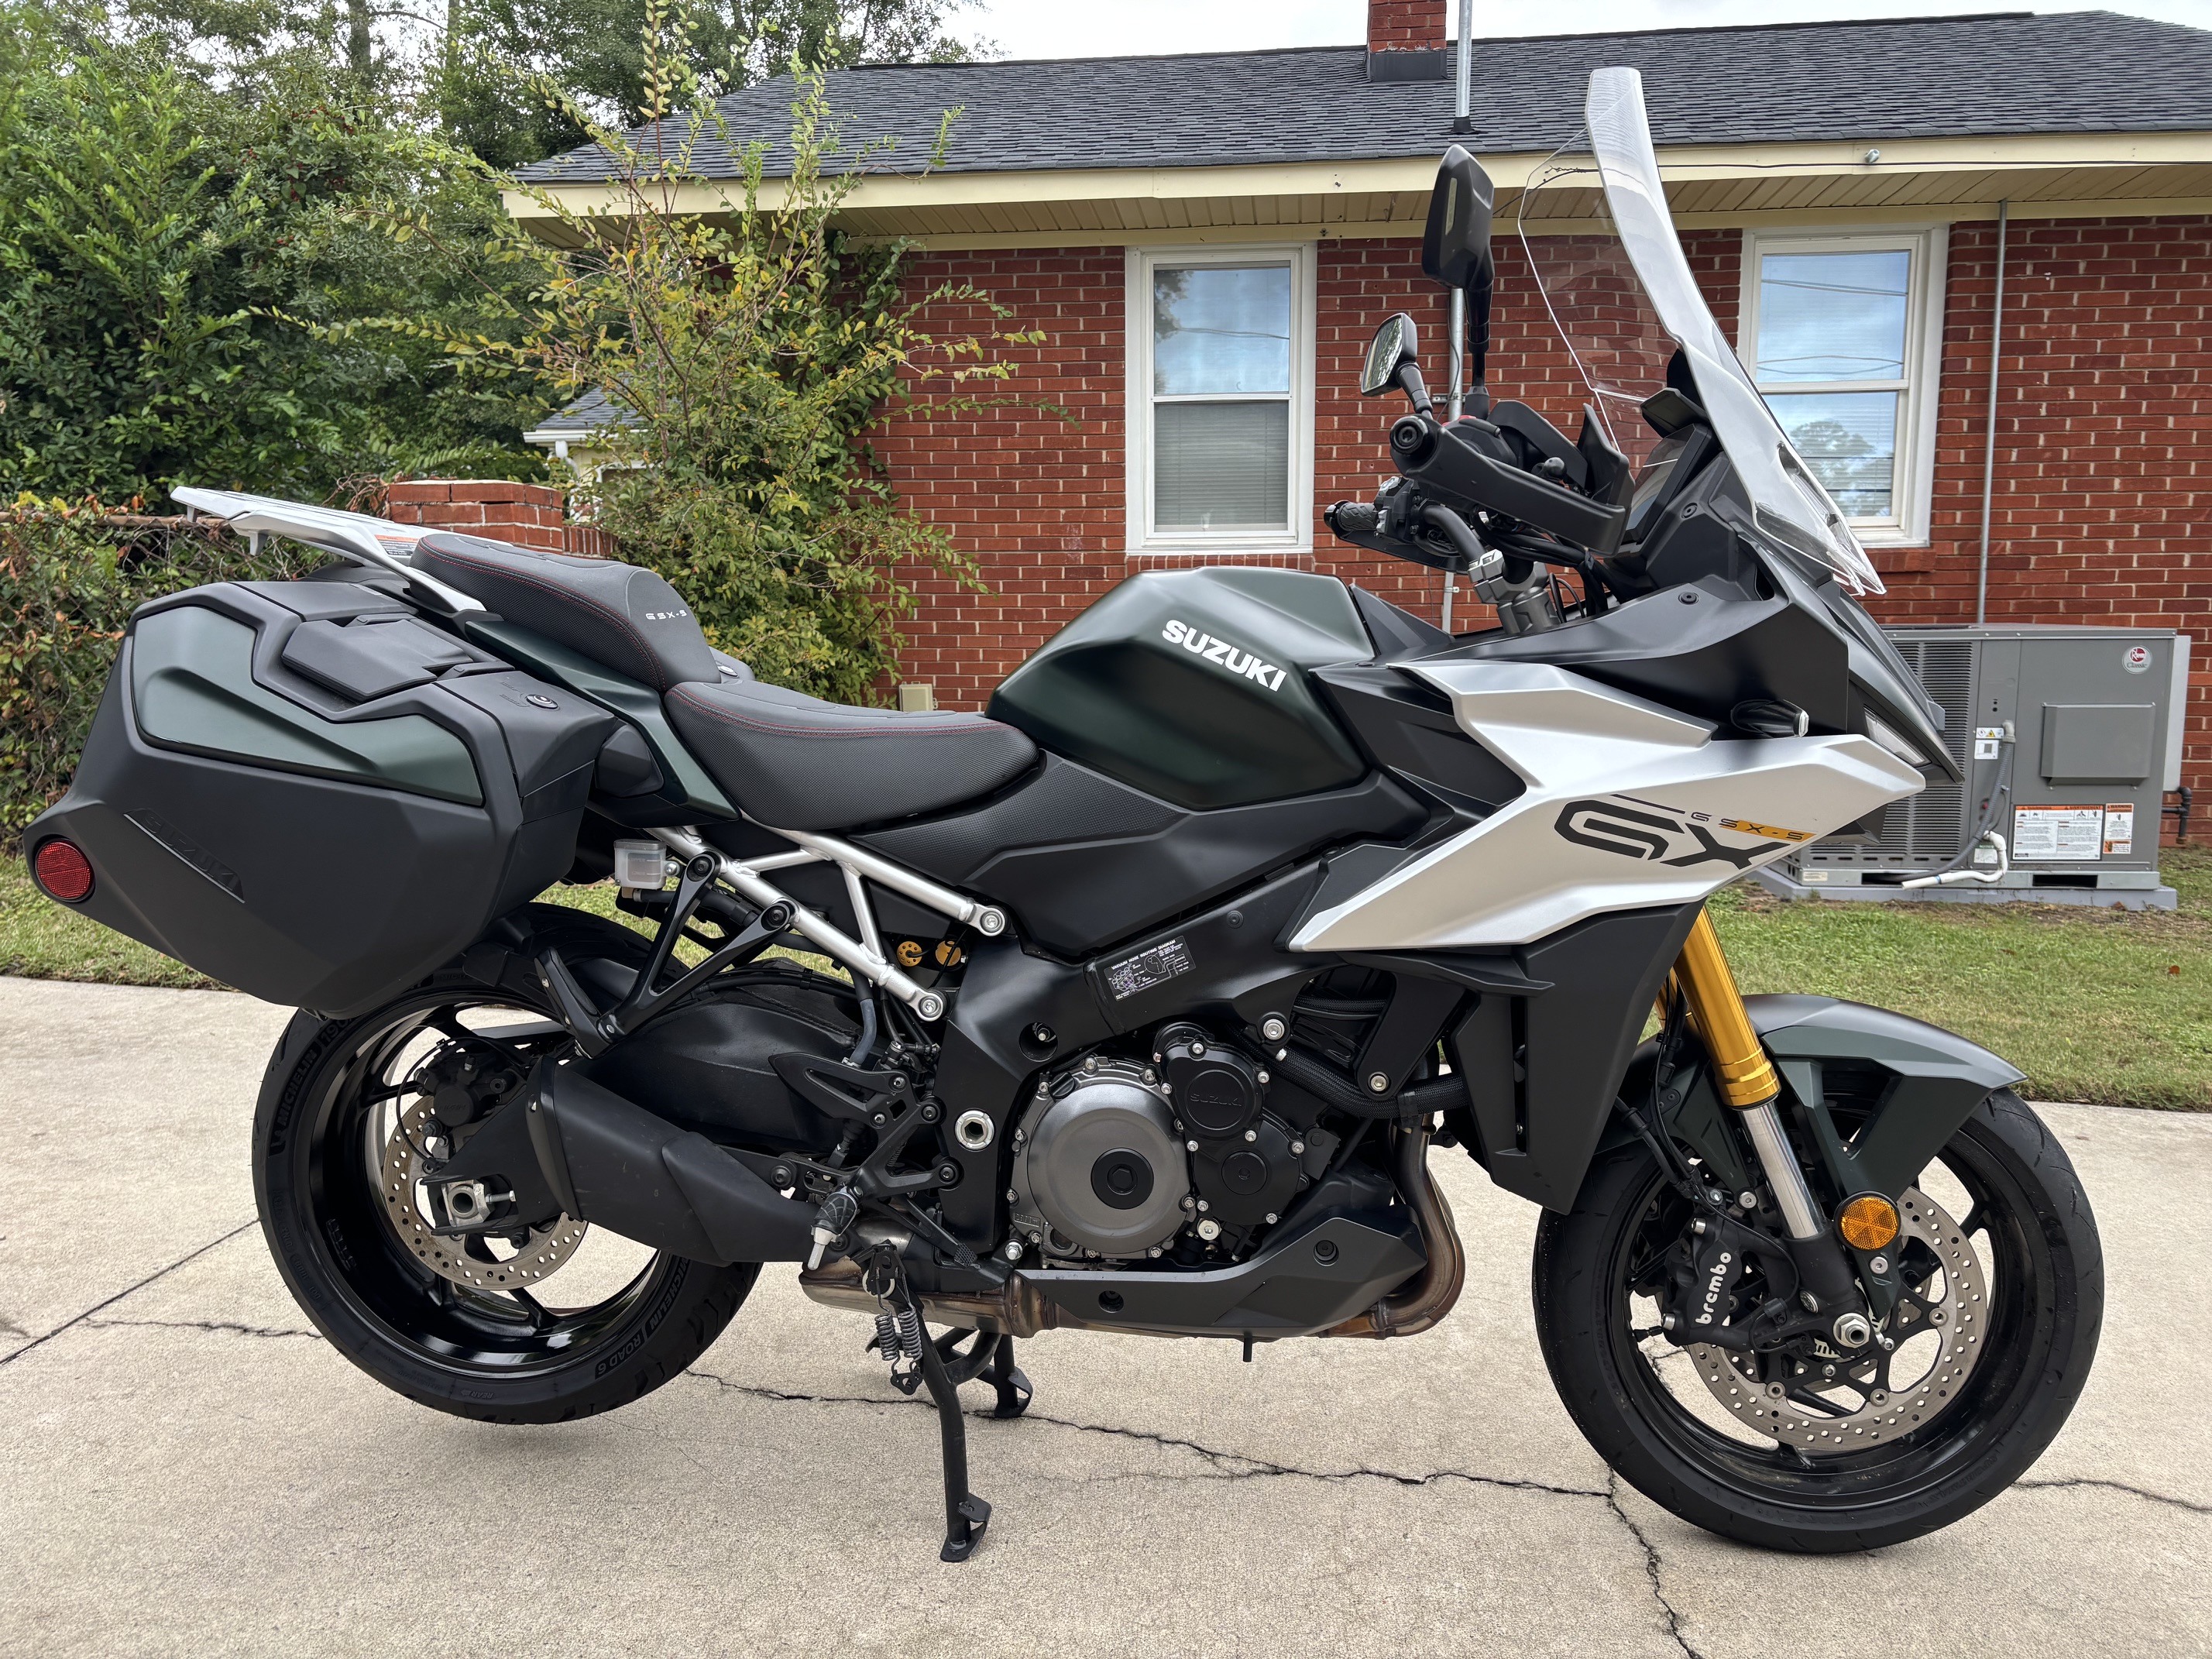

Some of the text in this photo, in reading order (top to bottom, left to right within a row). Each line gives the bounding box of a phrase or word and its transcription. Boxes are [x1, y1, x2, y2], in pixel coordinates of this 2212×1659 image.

[645, 610, 687, 620] GSX-S
[1162, 620, 1287, 692] SUZUKI
[1691, 812, 1805, 841] GSX-S
[143, 813, 238, 892] SUZUKI
[1111, 960, 1128, 970] VACUUM
[1140, 947, 1157, 957] ROUTING
[1158, 939, 1176, 950] DIAGRAM
[276, 1049, 318, 1124] MICHELIN
[1190, 1092, 1242, 1107] SUZUKI
[1695, 1252, 1732, 1324] brembo
[609, 1334, 642, 1368] ROAD
[598, 1363, 607, 1375] 6
[470, 1390, 495, 1400] REAR
